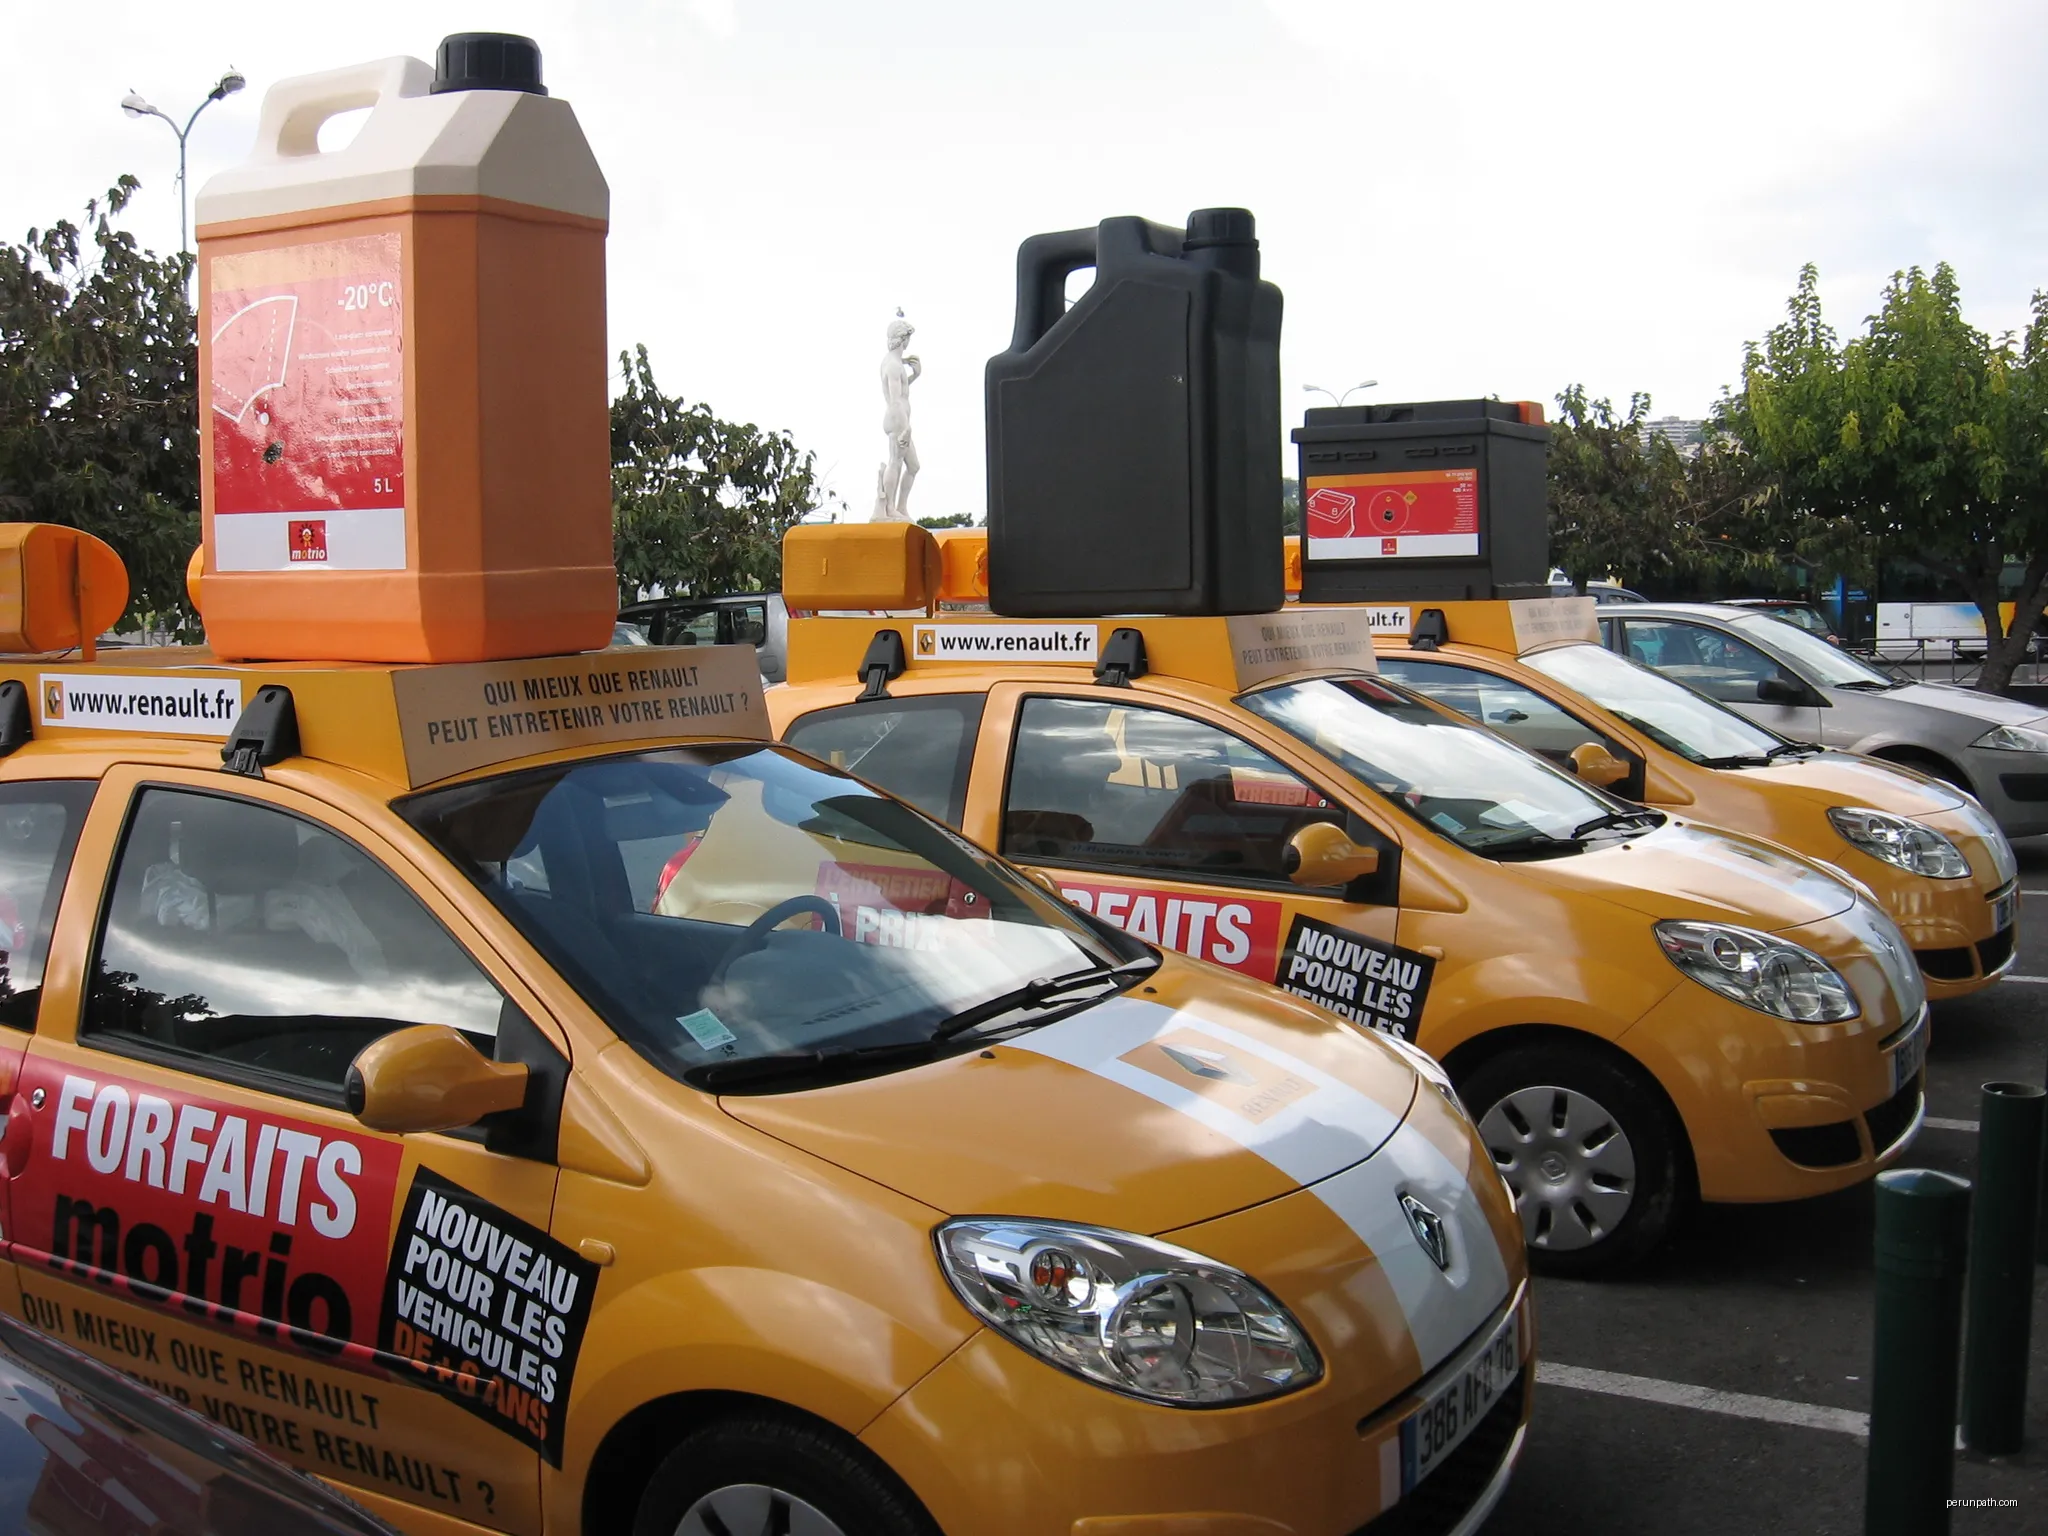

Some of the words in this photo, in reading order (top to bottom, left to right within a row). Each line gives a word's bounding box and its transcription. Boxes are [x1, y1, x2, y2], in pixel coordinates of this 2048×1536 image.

[337, 281, 393, 311] -20°C
[374, 478, 383, 493] 5
[384, 477, 394, 493] L
[291, 546, 326, 560] motrio
[940, 631, 1092, 652] www.renault.fr
[1367, 611, 1405, 626] ult.fr
[68, 688, 235, 720] www.renault.fr
[427, 717, 479, 745] PEUT
[487, 704, 605, 739] ENTRETENIR
[608, 699, 665, 724] VOTRE
[668, 692, 738, 718] RENAULT
[739, 691, 750, 712] ?
[483, 680, 517, 706] QUI
[522, 675, 582, 703] MIEUX
[588, 671, 623, 696] QUE
[629, 666, 699, 691] RENAULT
[1288, 955, 1359, 1001] POUR
[1362, 981, 1413, 1019] LES
[1295, 926, 1422, 991] NOUVEAU
[52, 1073, 363, 1240] FORFAITS
[51, 1193, 353, 1360] motrio
[415, 1188, 579, 1314] NOUVEAU
[404, 1234, 495, 1318] POUR
[501, 1289, 567, 1359] LES
[21, 1292, 65, 1334] QUI
[73, 1308, 161, 1365] MIEUX
[170, 1338, 229, 1385] QUE
[238, 1357, 380, 1430] RENAULT
[396, 1278, 558, 1403] VEHICULES
[482, 1374, 550, 1442] ANS
[1419, 1388, 1458, 1466] 386
[201, 1394, 305, 1454] VOTRE
[312, 1428, 462, 1504] RENAULT
[476, 1479, 496, 1514] ?
